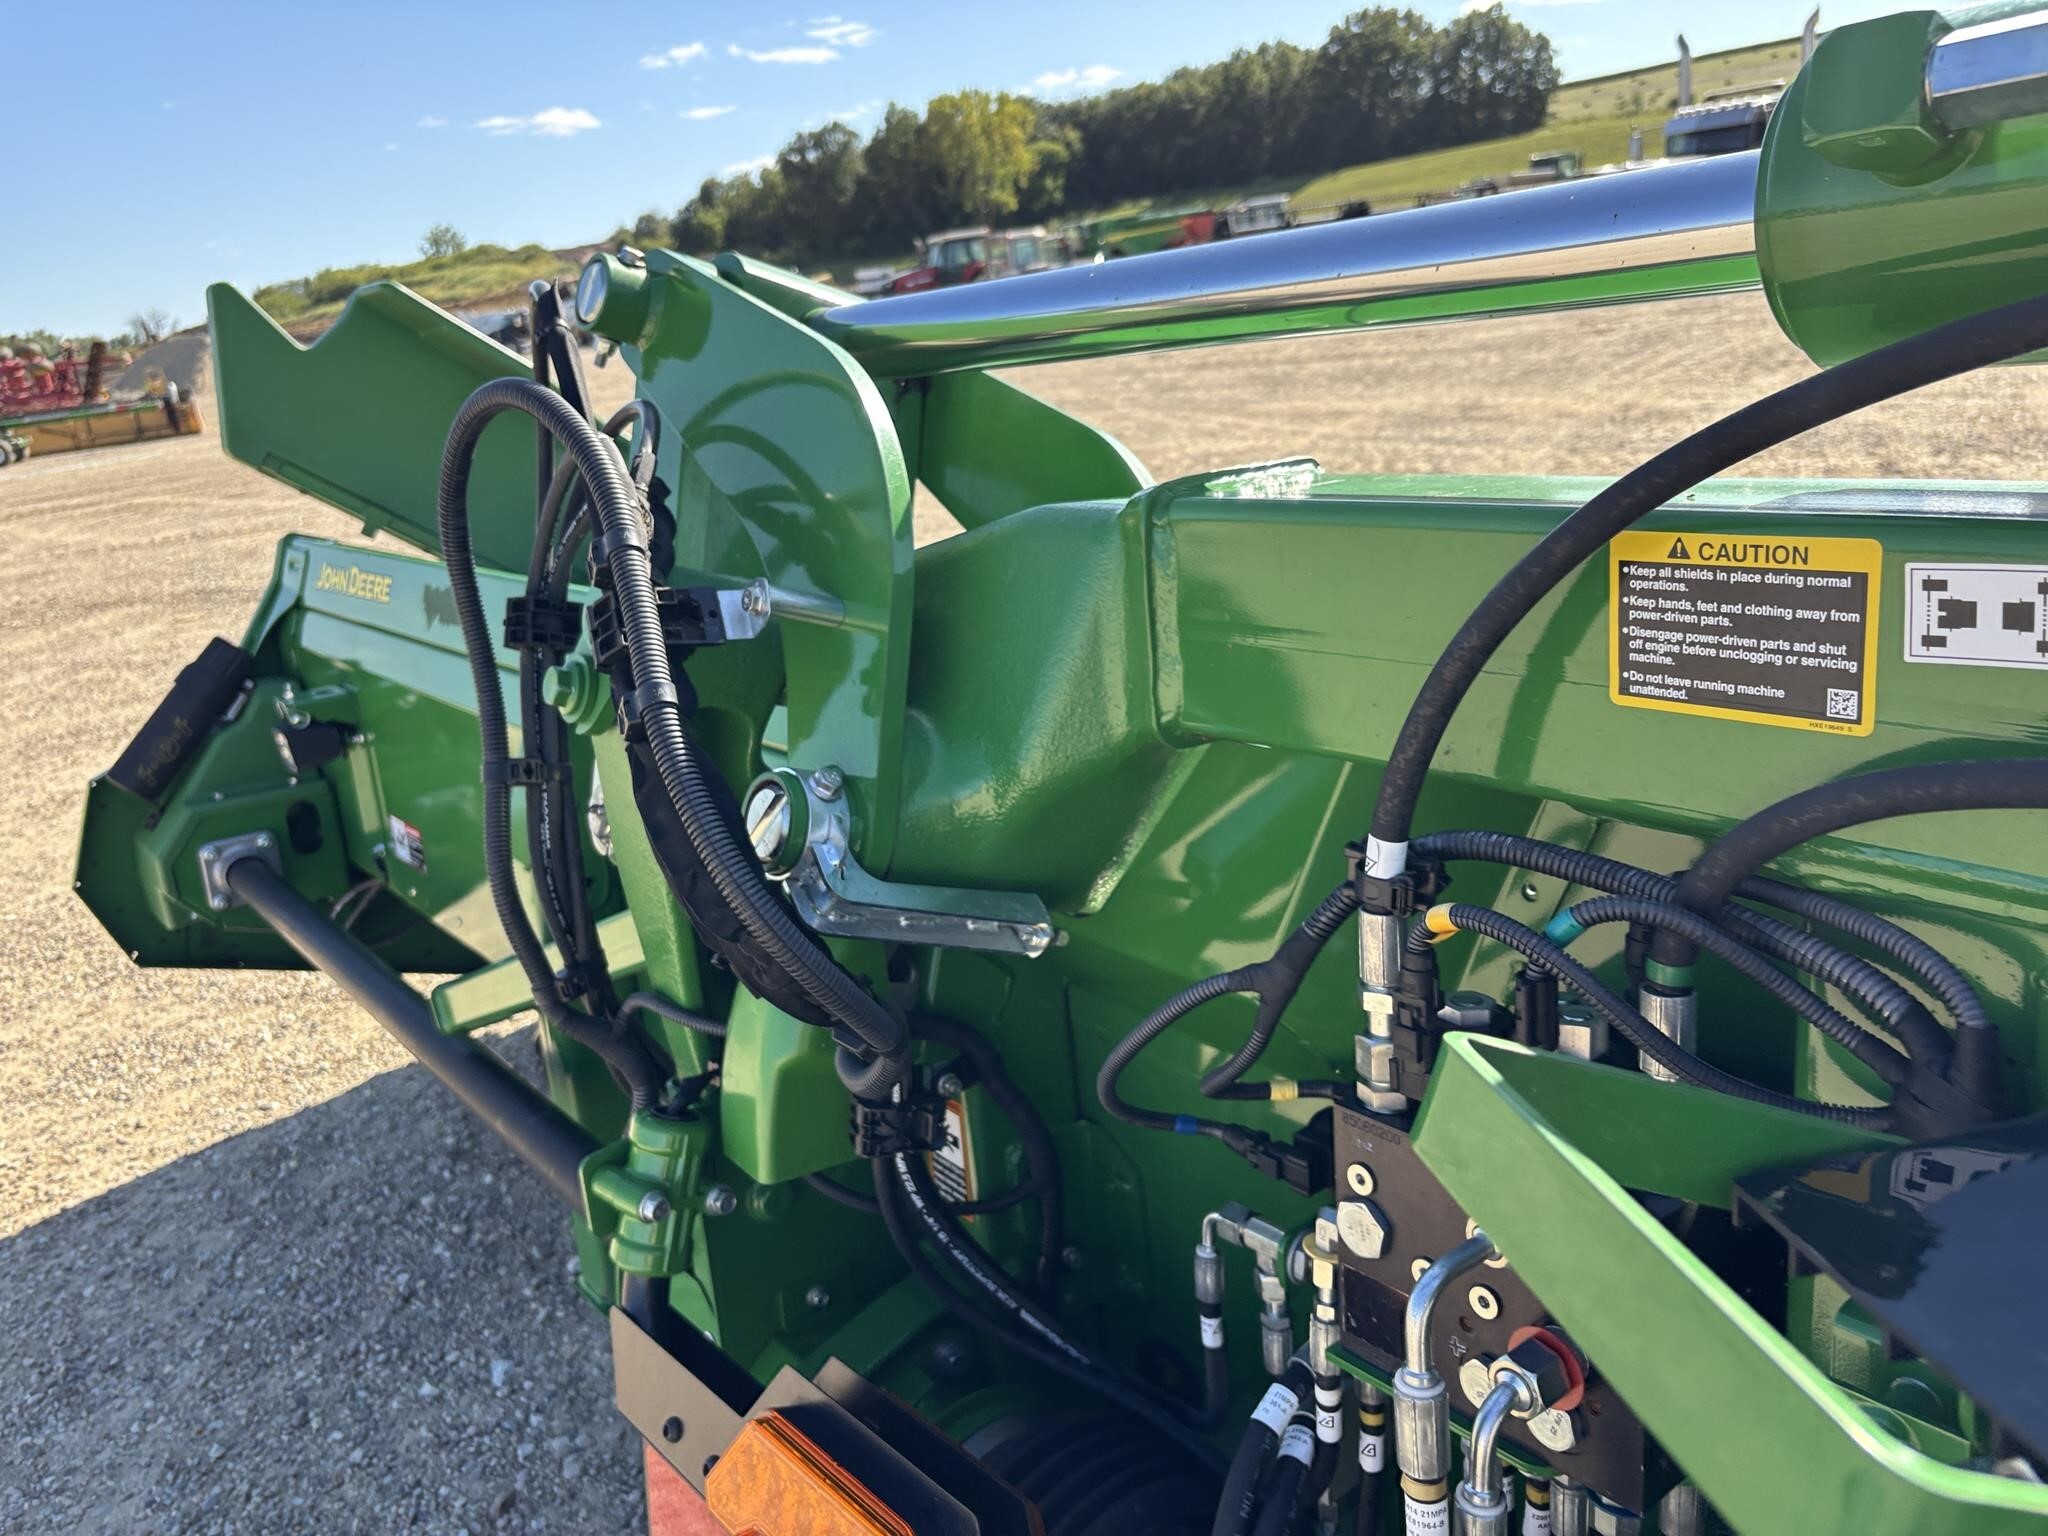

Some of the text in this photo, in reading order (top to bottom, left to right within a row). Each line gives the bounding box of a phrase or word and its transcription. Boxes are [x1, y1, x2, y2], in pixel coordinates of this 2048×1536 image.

[1698, 541, 1809, 566] CAUTION
[316, 561, 393, 603] JOHN DEERE
[1629, 565, 1852, 588] Keep all shields in place during normal
[1629, 580, 1689, 592] operations.
[1629, 595, 1860, 622] Keep hands, feet and clothing away from
[1629, 609, 1733, 627] power-driven parts.
[1629, 626, 1847, 655] Disengage power-driven parts and shut
[1629, 639, 1858, 673] off engine before unclogging or servicing
[1629, 652, 1676, 665] machine.
[1629, 670, 1786, 698] Do not leave running machine
[1629, 684, 1689, 700] unattended.
